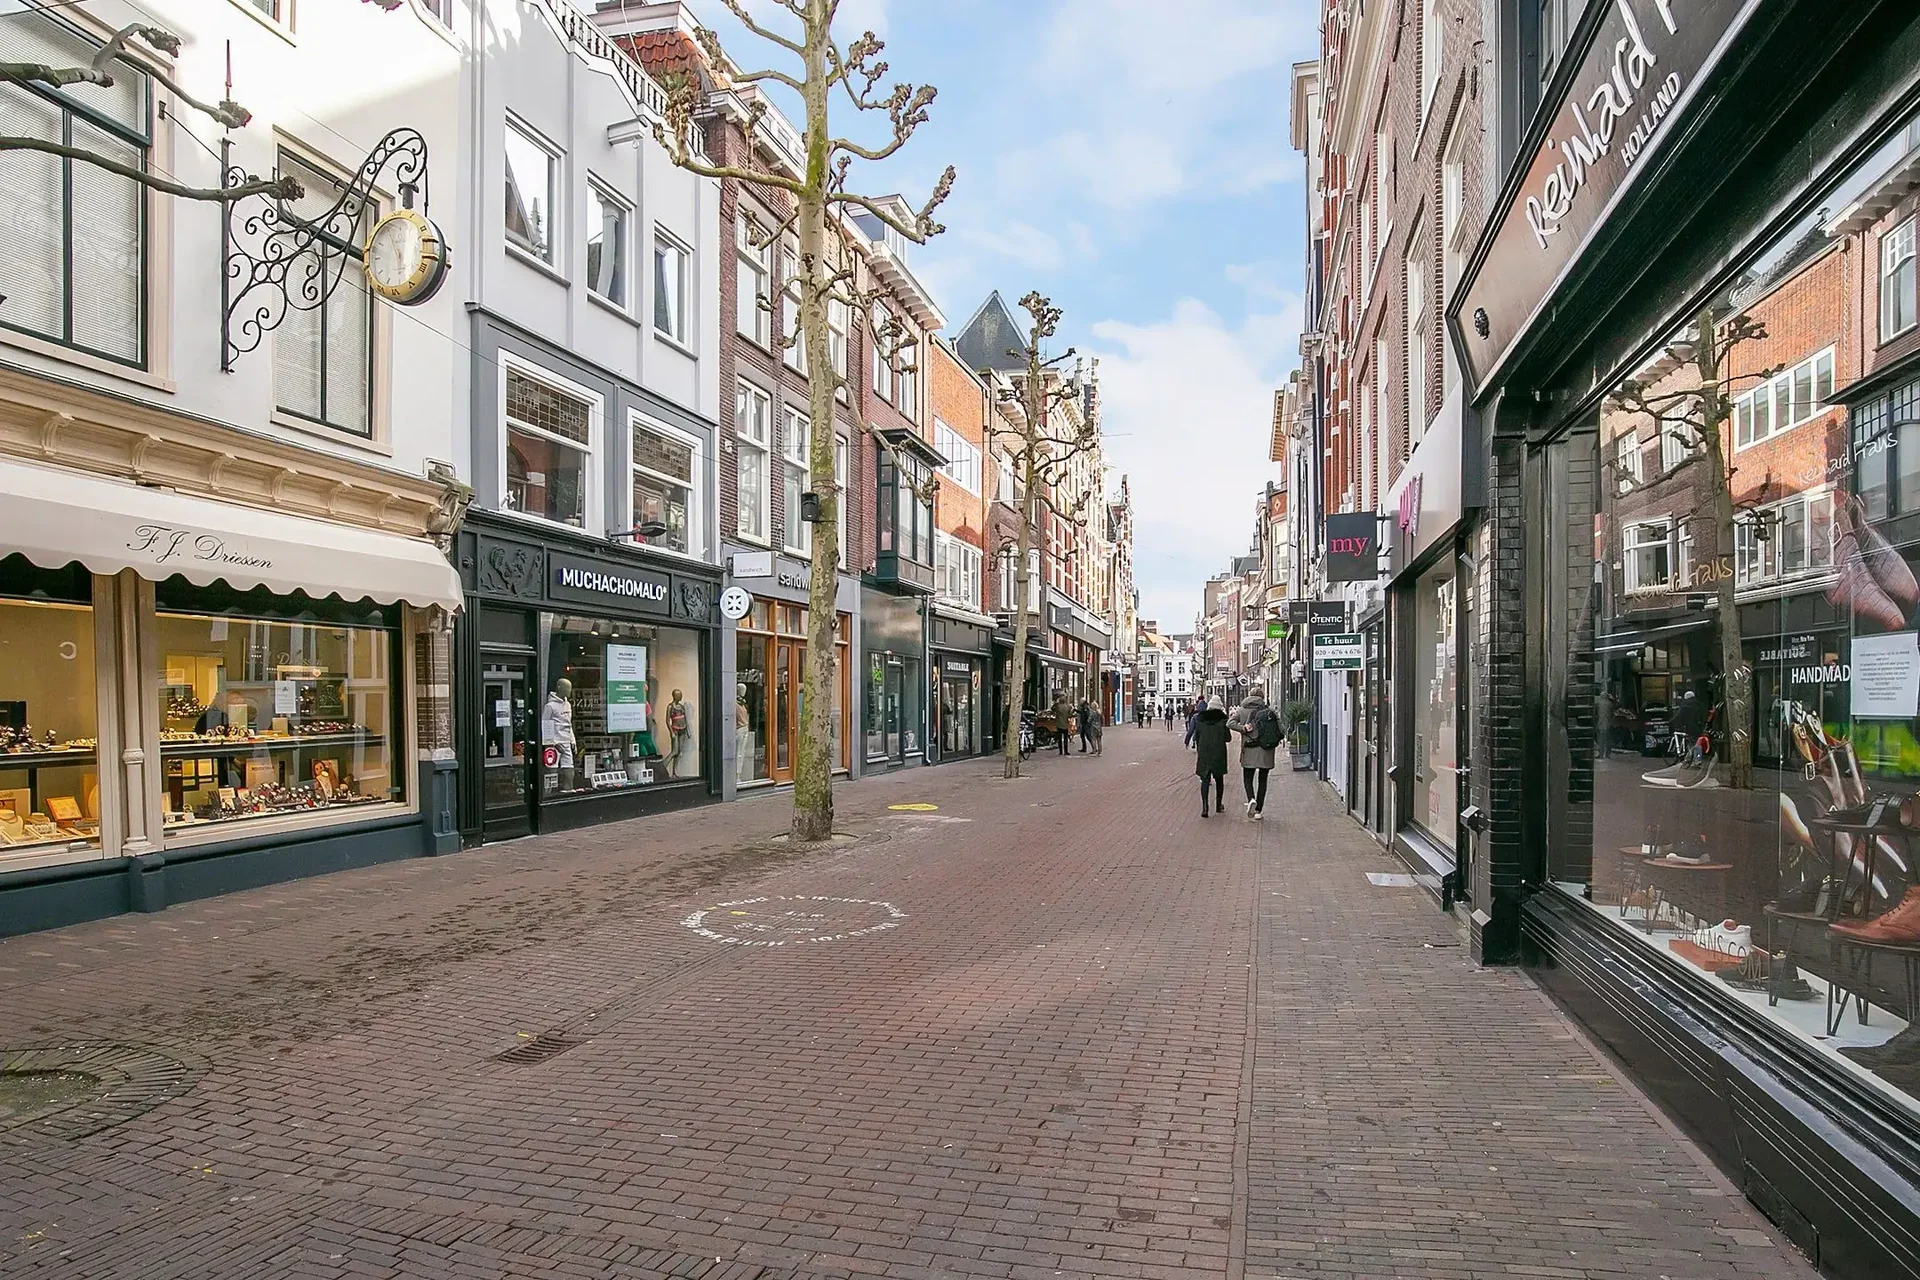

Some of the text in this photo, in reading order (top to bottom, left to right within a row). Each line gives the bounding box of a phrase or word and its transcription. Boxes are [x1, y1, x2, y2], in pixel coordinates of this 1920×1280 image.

[1620, 72, 1681, 168] HOLLAND
[1853, 432, 1898, 462] Frans
[194, 534, 274, 569] Driessen
[1331, 536, 1369, 557] my
[1322, 636, 1354, 645] Te huur
[1791, 664, 1852, 684] HANDMAD
